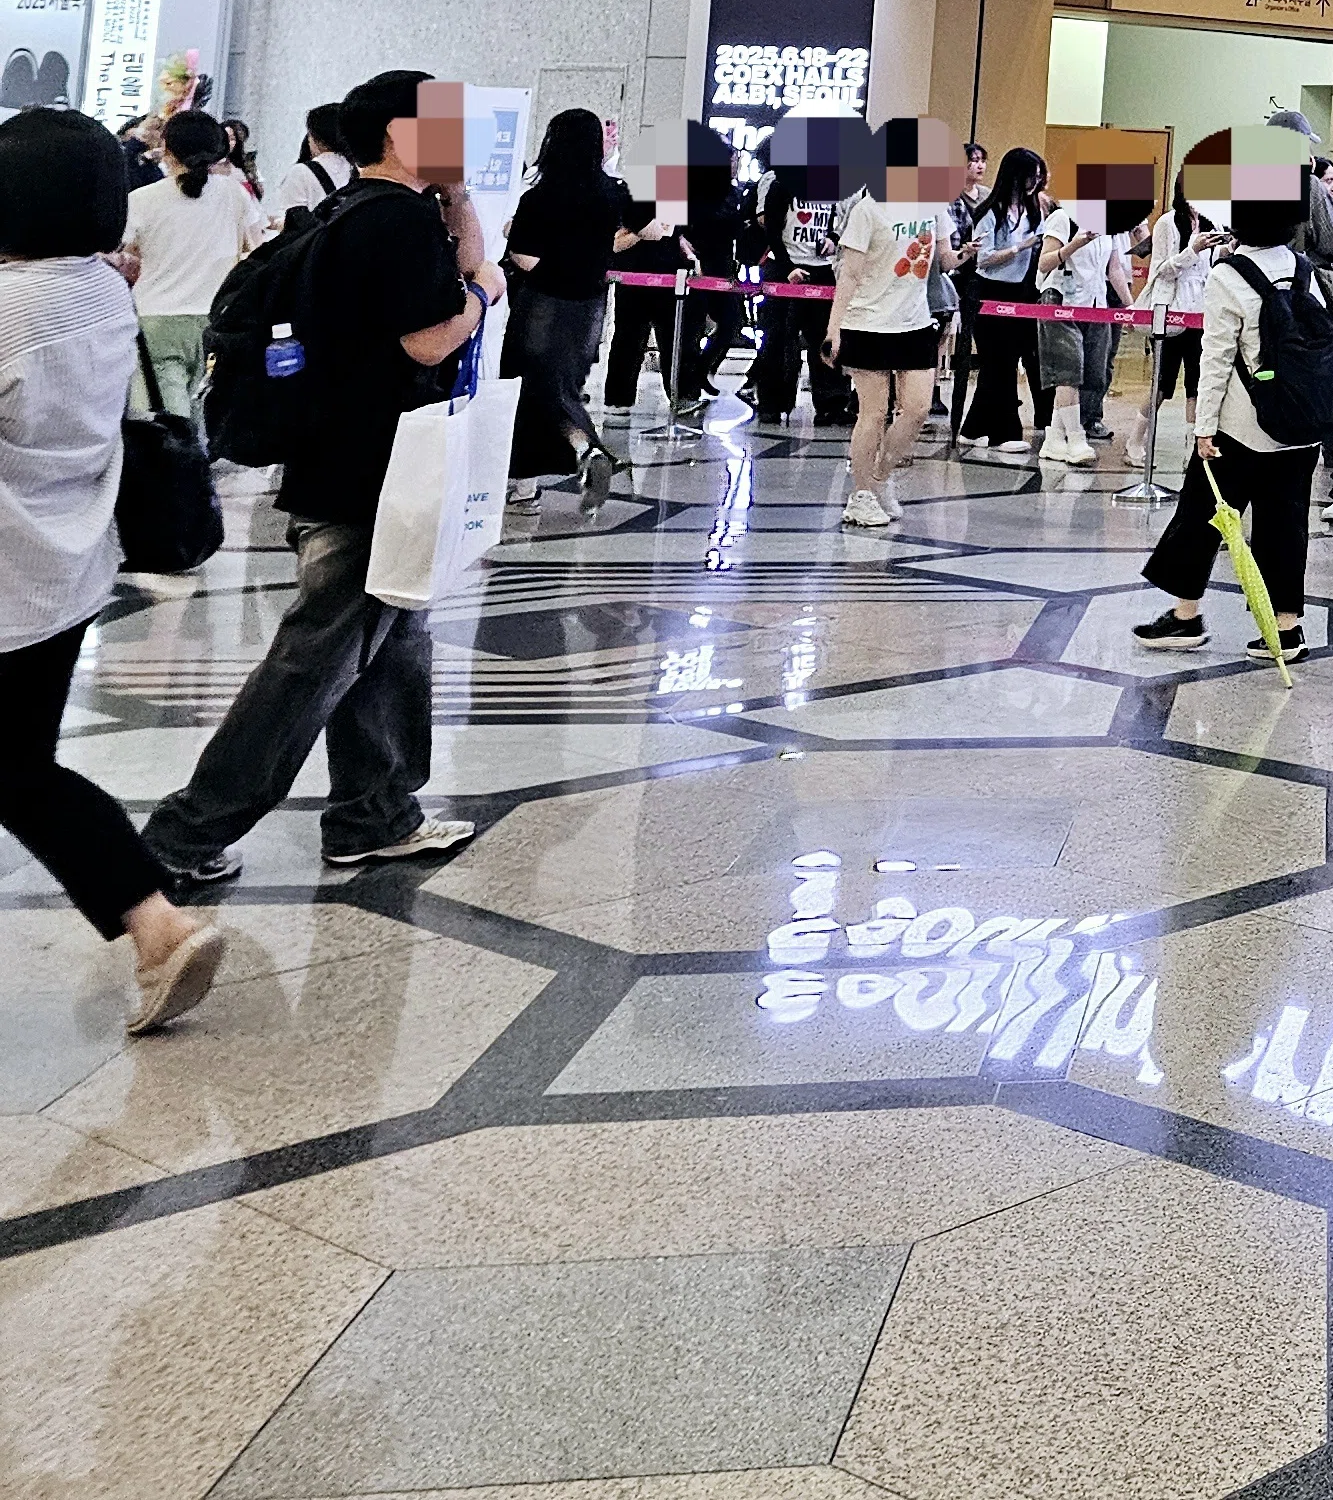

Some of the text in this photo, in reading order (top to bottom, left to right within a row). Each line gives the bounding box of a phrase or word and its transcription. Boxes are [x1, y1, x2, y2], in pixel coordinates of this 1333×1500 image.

[713, 64, 865, 88] COEX HALLS
[782, 86, 865, 108] SEOUL
[1113, 312, 1136, 322] coex
[467, 492, 490, 503] AVE
